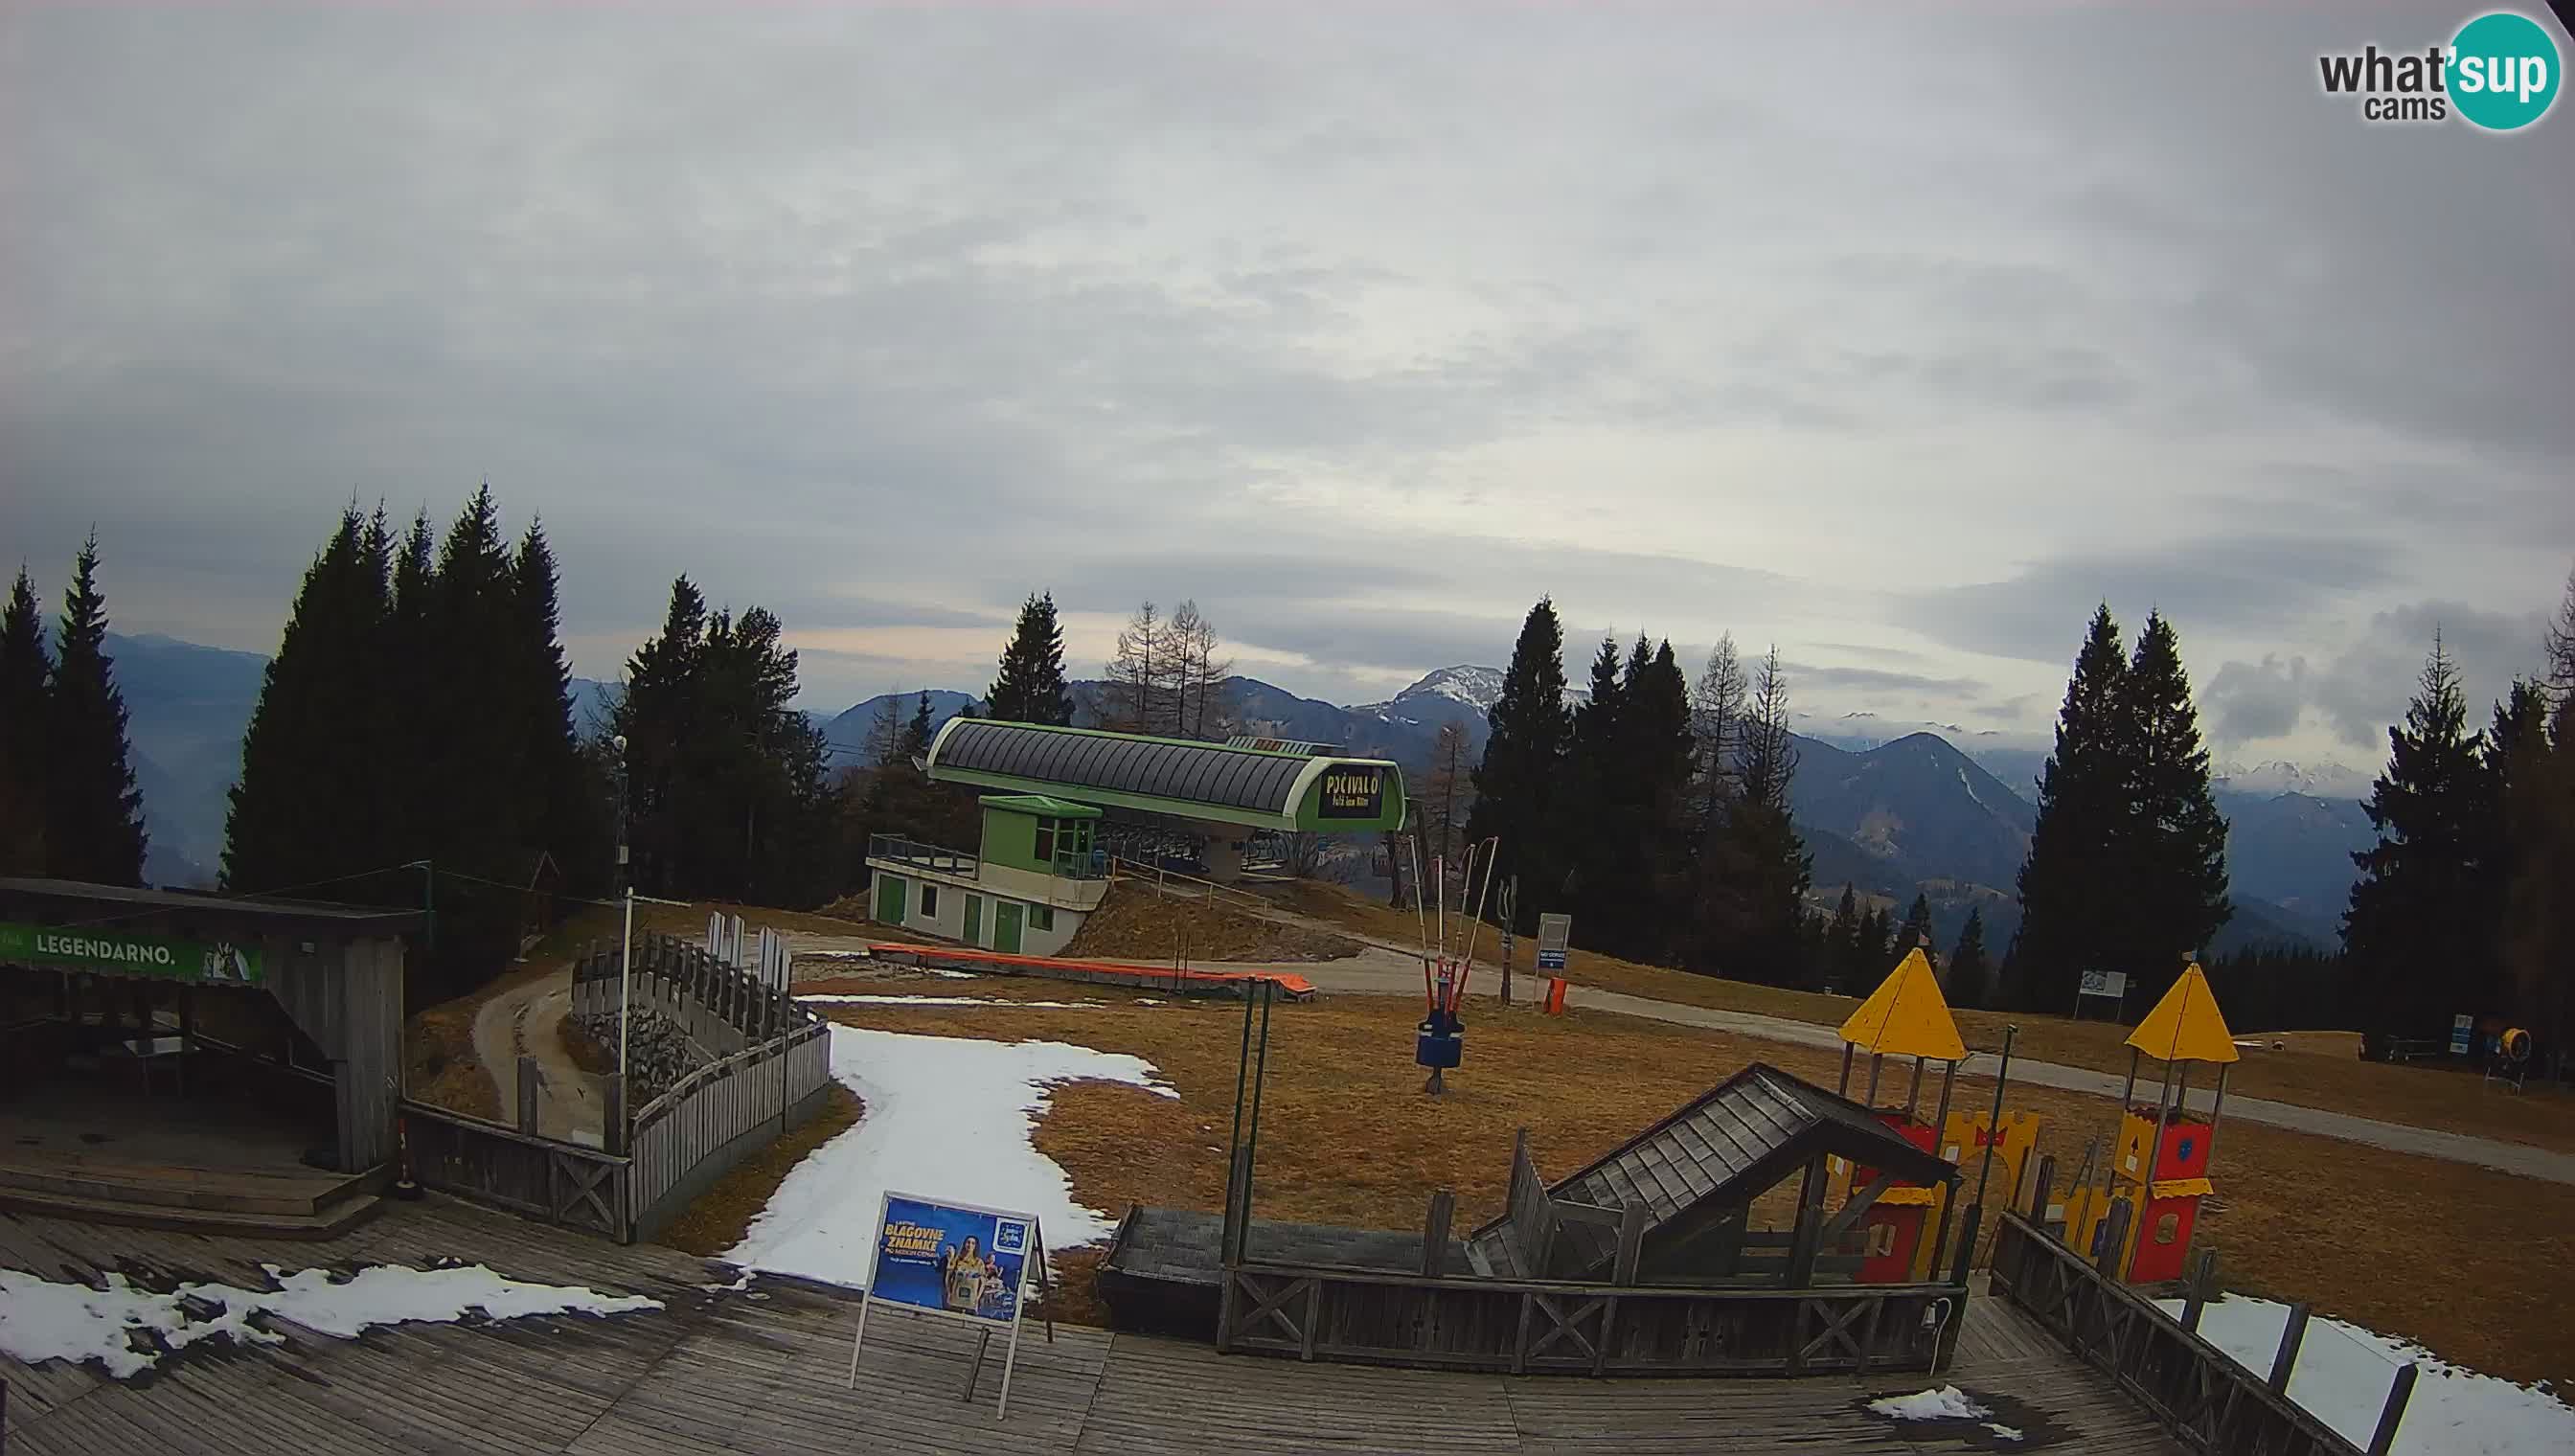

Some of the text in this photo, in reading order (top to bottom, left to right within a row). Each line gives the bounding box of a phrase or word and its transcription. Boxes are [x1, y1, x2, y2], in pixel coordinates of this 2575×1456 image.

[36, 934, 176, 966] LEGENDARNO.
[885, 1223, 946, 1240] BLAGOVNE
[887, 1236, 939, 1251] ZNAMKE
